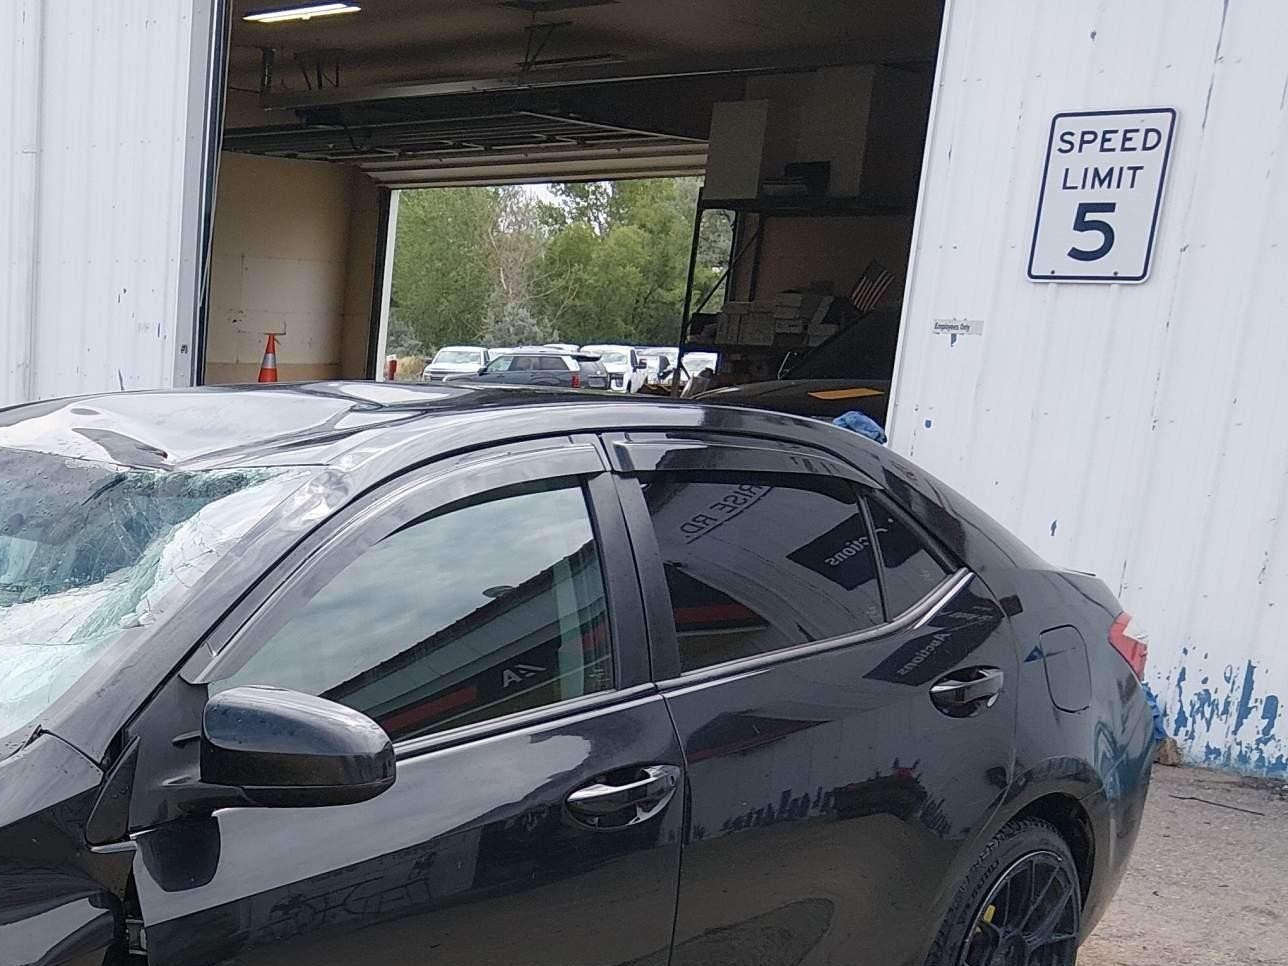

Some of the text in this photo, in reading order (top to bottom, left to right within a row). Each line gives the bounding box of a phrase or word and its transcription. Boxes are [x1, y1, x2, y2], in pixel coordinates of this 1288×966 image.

[1057, 127, 1162, 154] SPEED
[1062, 165, 1145, 190] LIMIT
[1066, 202, 1117, 262] 5
